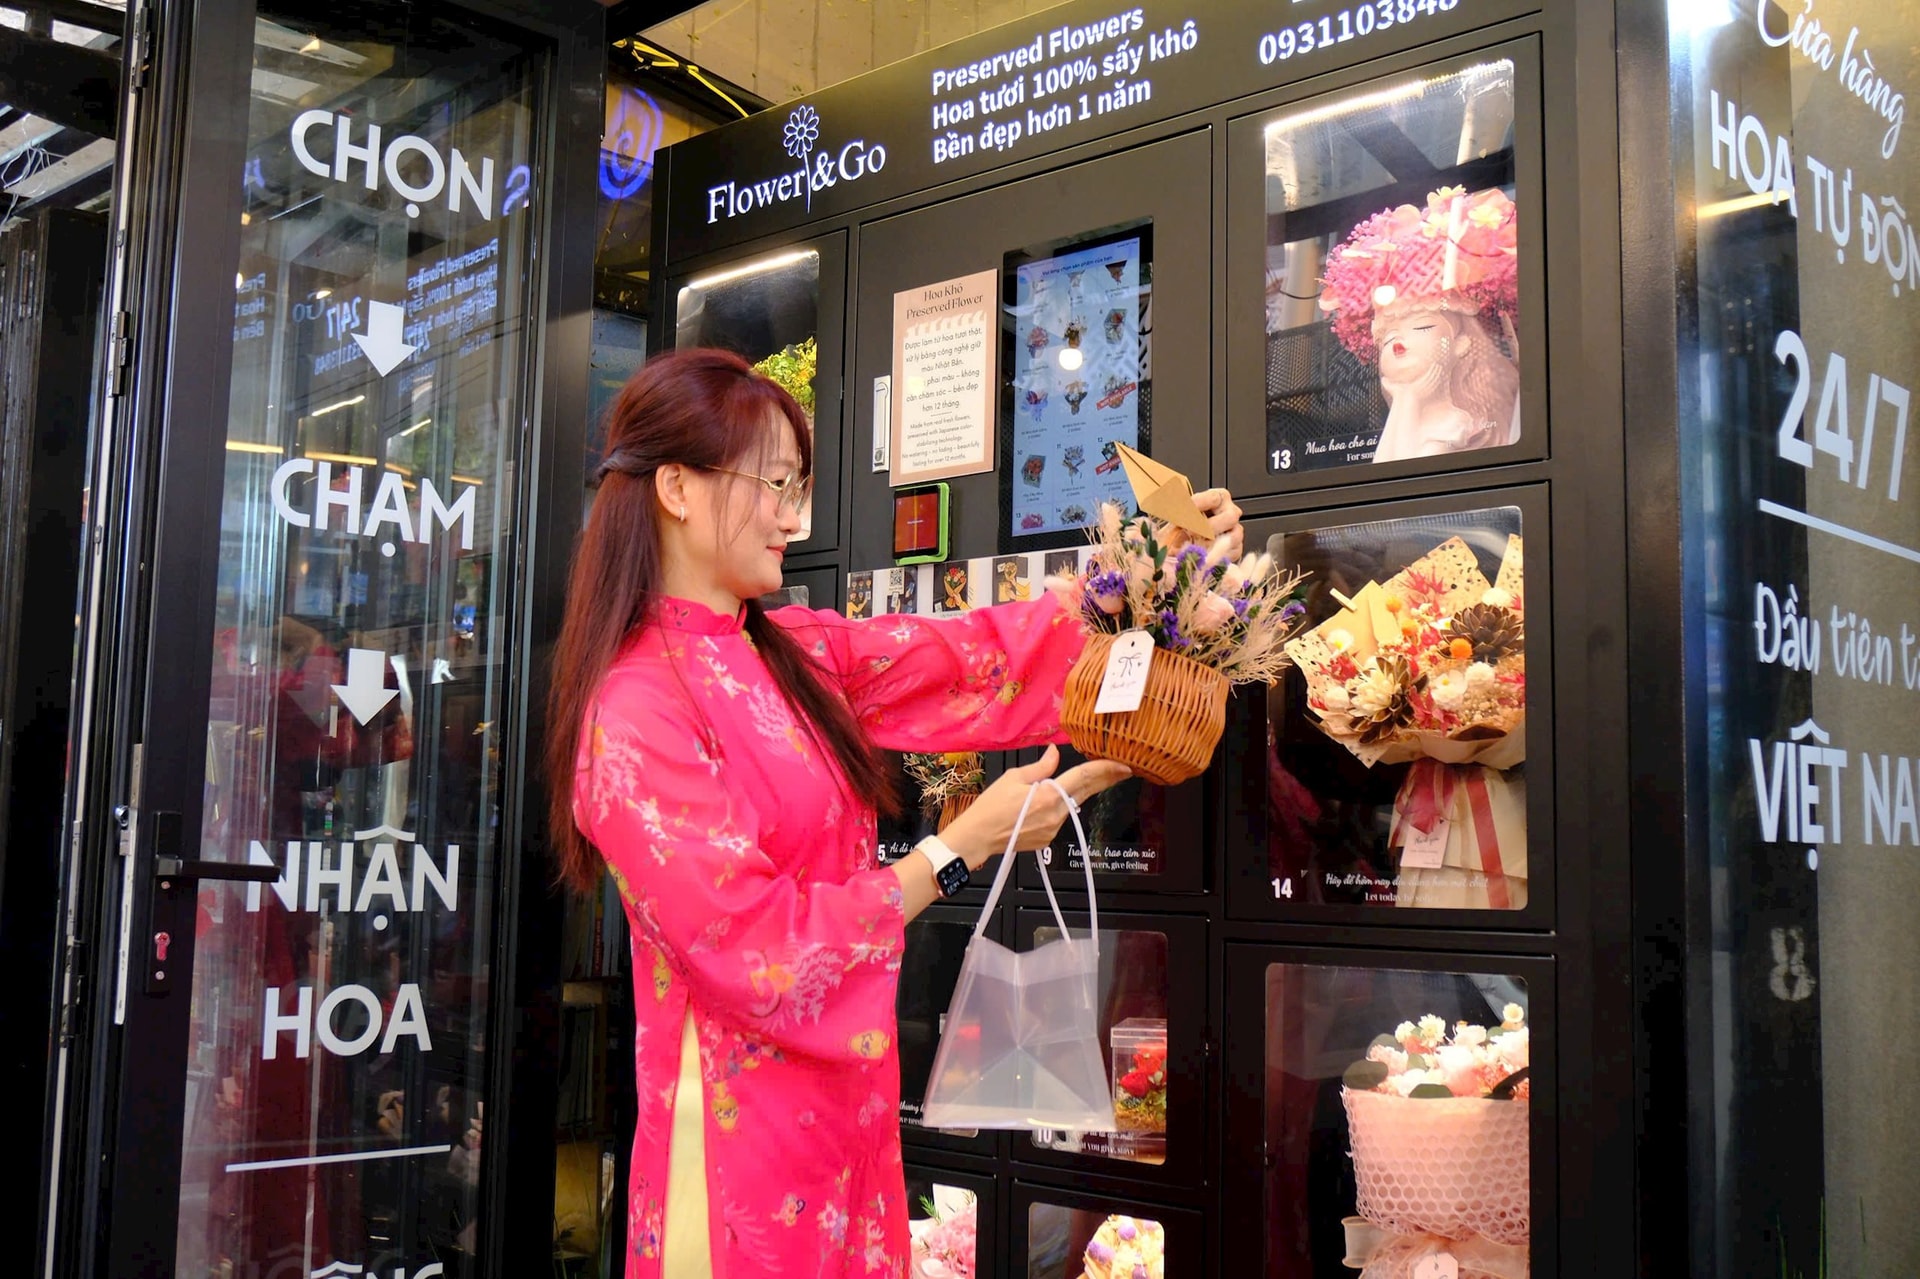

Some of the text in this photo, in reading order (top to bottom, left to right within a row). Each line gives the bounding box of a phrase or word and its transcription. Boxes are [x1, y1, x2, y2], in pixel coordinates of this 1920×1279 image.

[931, 8, 1145, 96] Preserved Flowers
[932, 20, 1198, 130] Hoa tươi 100% sấy khô
[1757, 0, 1906, 160] Cửa hàng
[933, 79, 1152, 164] Bền đẹp hơn 1 năm
[291, 109, 494, 222] CHỌN
[1710, 89, 1797, 218] HOA
[1806, 154, 1852, 265] TỰ
[906, 294, 984, 320] Preserved Flower
[923, 282, 964, 301] Hoa Khô
[934, 402, 941, 410] 12
[1774, 329, 1910, 502] 24/7
[1271, 449, 1292, 470] 13
[1304, 442, 1327, 456] Mua
[1328, 439, 1347, 452] hoa
[1348, 435, 1365, 449] cho
[1365, 436, 1378, 447] ai
[1346, 452, 1359, 462] For
[270, 458, 477, 558] CHẠM
[1753, 582, 1822, 676] Đầu
[1830, 604, 1894, 687] tiên
[1748, 717, 1920, 871] VIỆT NA
[246, 824, 460, 931] NHẬN
[877, 843, 886, 861] 5
[1042, 846, 1052, 865] 9
[1104, 845, 1122, 858] trao
[1110, 861, 1125, 871] give
[1125, 860, 1149, 872] feeling
[1272, 877, 1293, 898] 14
[1364, 891, 1378, 901] Let
[262, 983, 433, 1061] HOA
